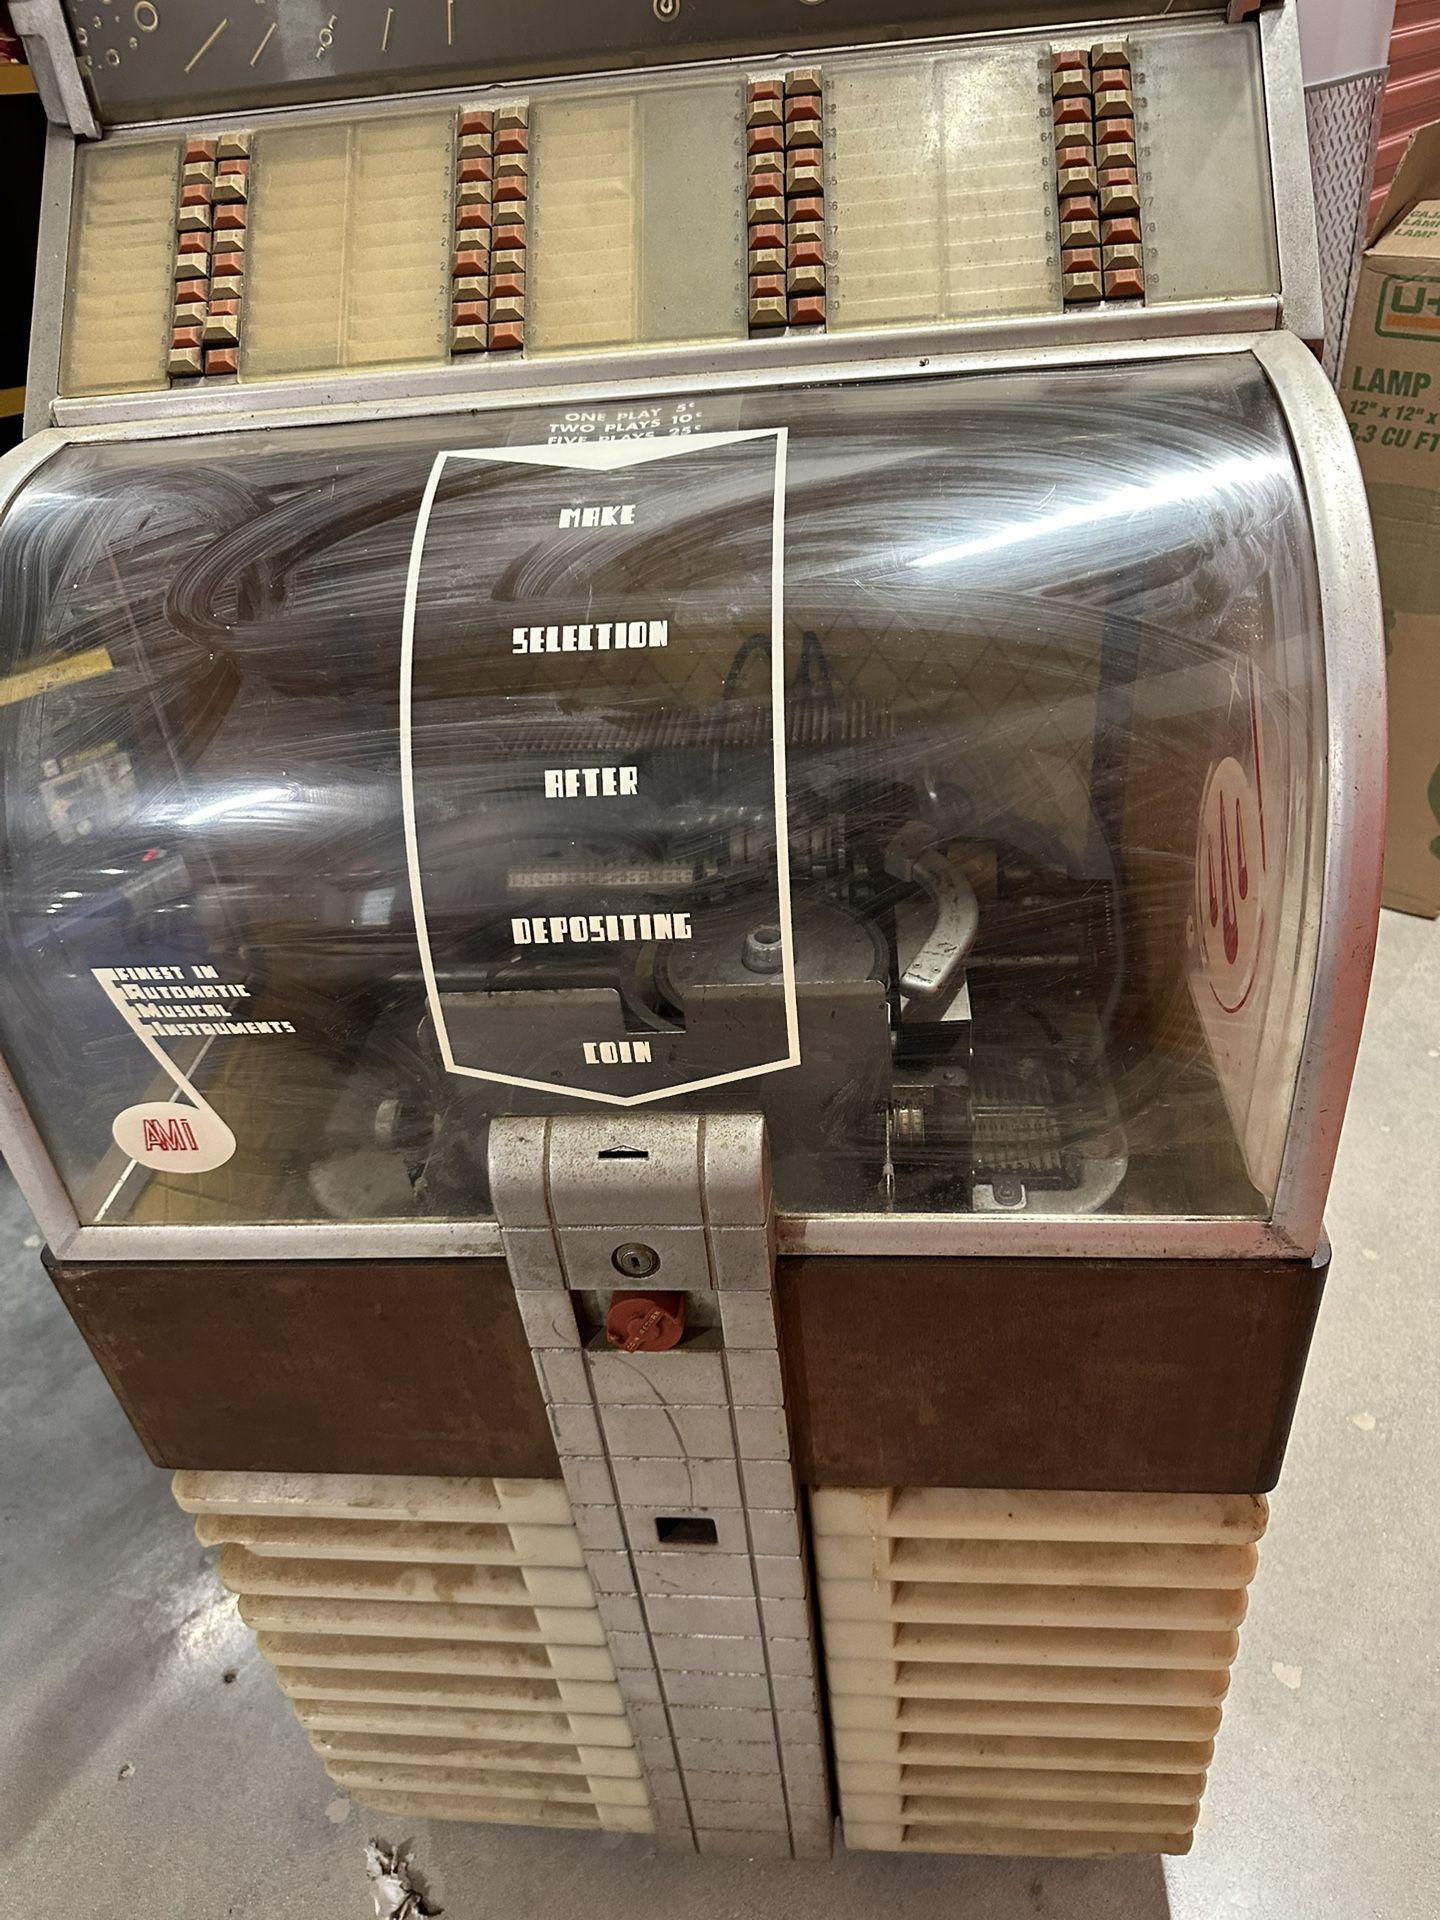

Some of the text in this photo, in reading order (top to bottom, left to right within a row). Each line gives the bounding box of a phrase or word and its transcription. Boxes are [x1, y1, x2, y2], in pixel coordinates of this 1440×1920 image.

[1410, 210, 1440, 219] CAJ
[1394, 228, 1438, 238] LAMP
[1352, 366, 1432, 398] LAMP
[564, 412, 607, 422] ONE
[616, 407, 663, 421] PLAY
[1349, 400, 1440, 425] 12" x 12" x
[549, 423, 596, 433] TWO
[604, 418, 661, 433] PLAYS
[548, 436, 588, 445] FIVE
[1381, 426, 1412, 448] CU
[1414, 430, 1440, 452] FT
[558, 504, 636, 529] MAKE
[512, 620, 668, 654] SELECTION
[544, 766, 638, 798] AFTER
[511, 912, 692, 945] DEPOSITING
[114, 965, 219, 981] FINEST IN
[120, 983, 251, 1000] AUTOMATIC
[132, 1003, 232, 1018] MUSICAL
[152, 1021, 297, 1037] INSTRUMENTS
[583, 1041, 652, 1064] COIN
